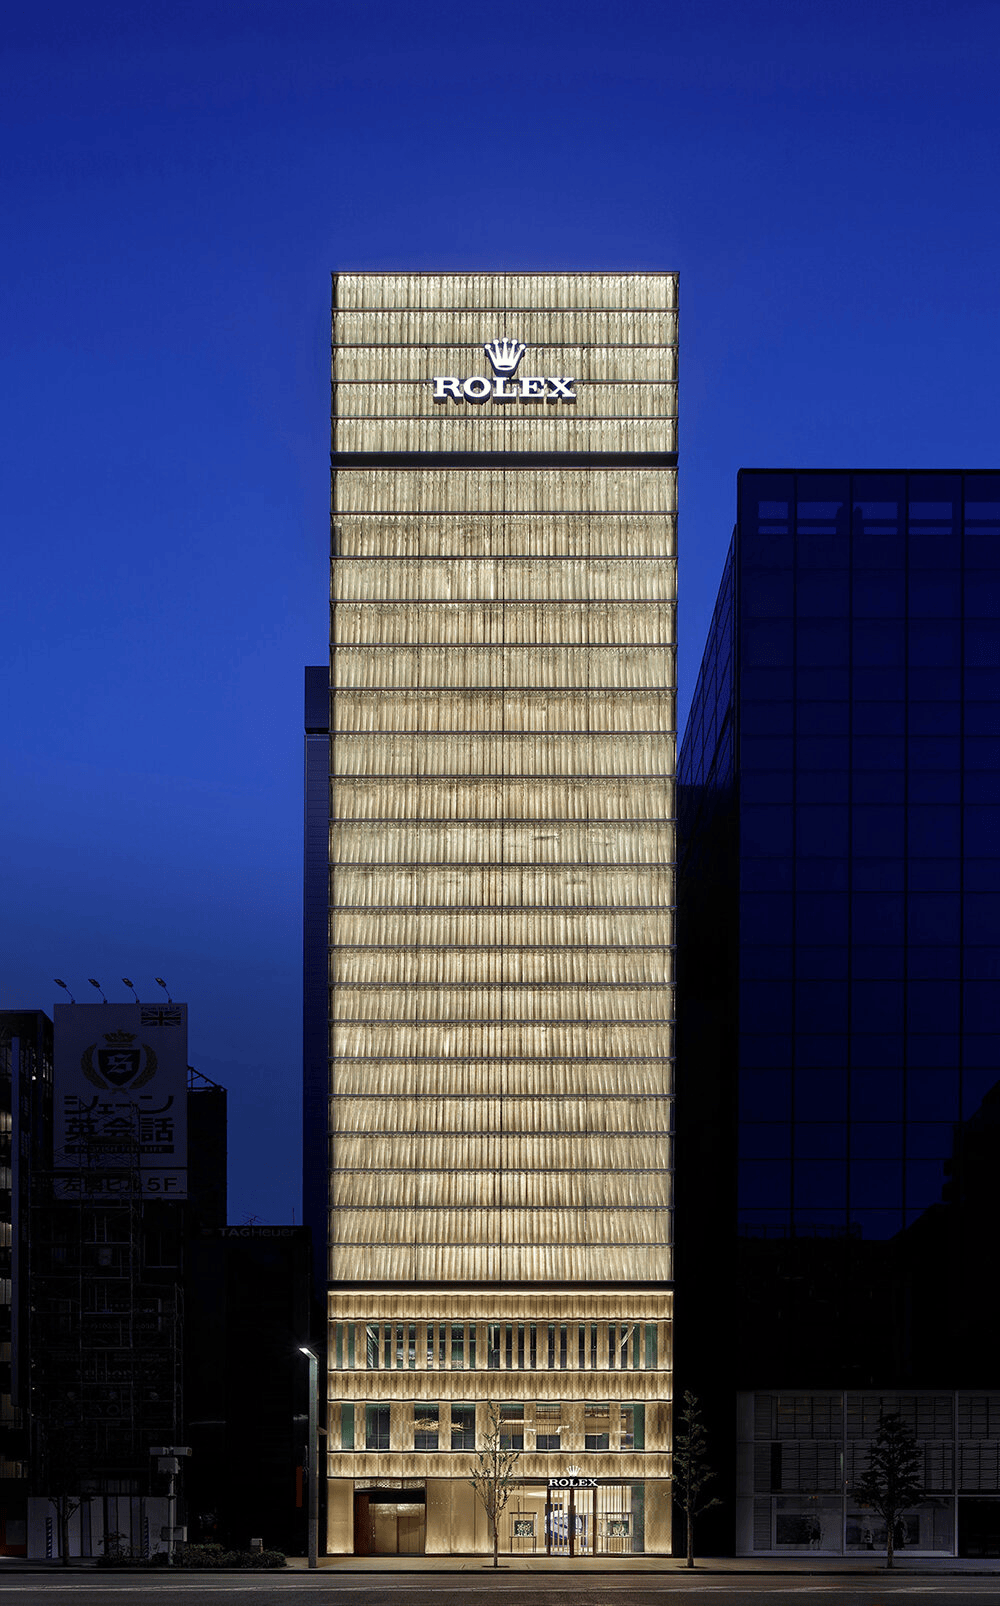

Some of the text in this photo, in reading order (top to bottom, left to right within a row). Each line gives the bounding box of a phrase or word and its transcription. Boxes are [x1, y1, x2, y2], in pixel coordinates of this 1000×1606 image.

[433, 376, 577, 399] ROLEX
[64, 1095, 174, 1115] シェーン
[65, 1117, 175, 1142] 英会話
[147, 1177, 178, 1192] 5F
[548, 1478, 599, 1487] ROLEX
